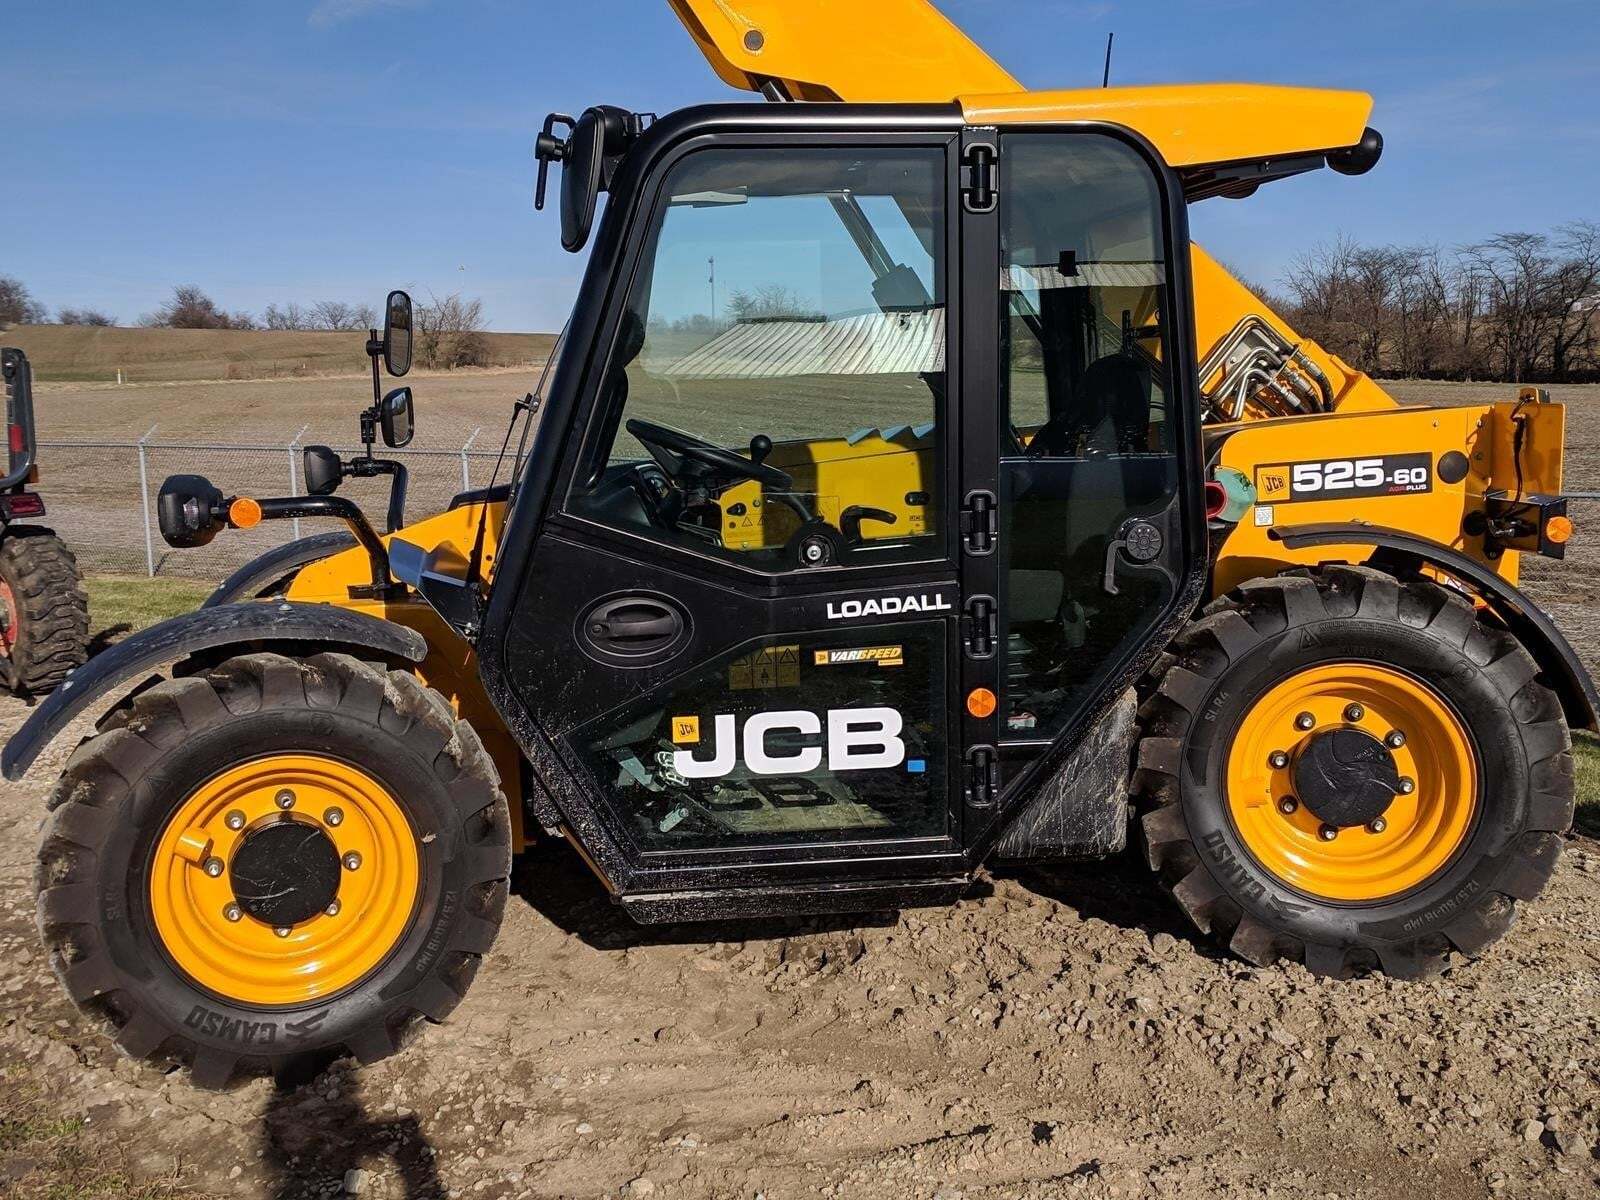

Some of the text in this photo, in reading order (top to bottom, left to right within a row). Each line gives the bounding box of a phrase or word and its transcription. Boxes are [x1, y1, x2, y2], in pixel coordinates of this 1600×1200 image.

[1264, 475, 1285, 492] JCB
[827, 593, 952, 619] LOADALL
[673, 706, 906, 779] JCB
[1202, 829, 1267, 903] CAMSO
[183, 1004, 279, 1046] CAMSO
